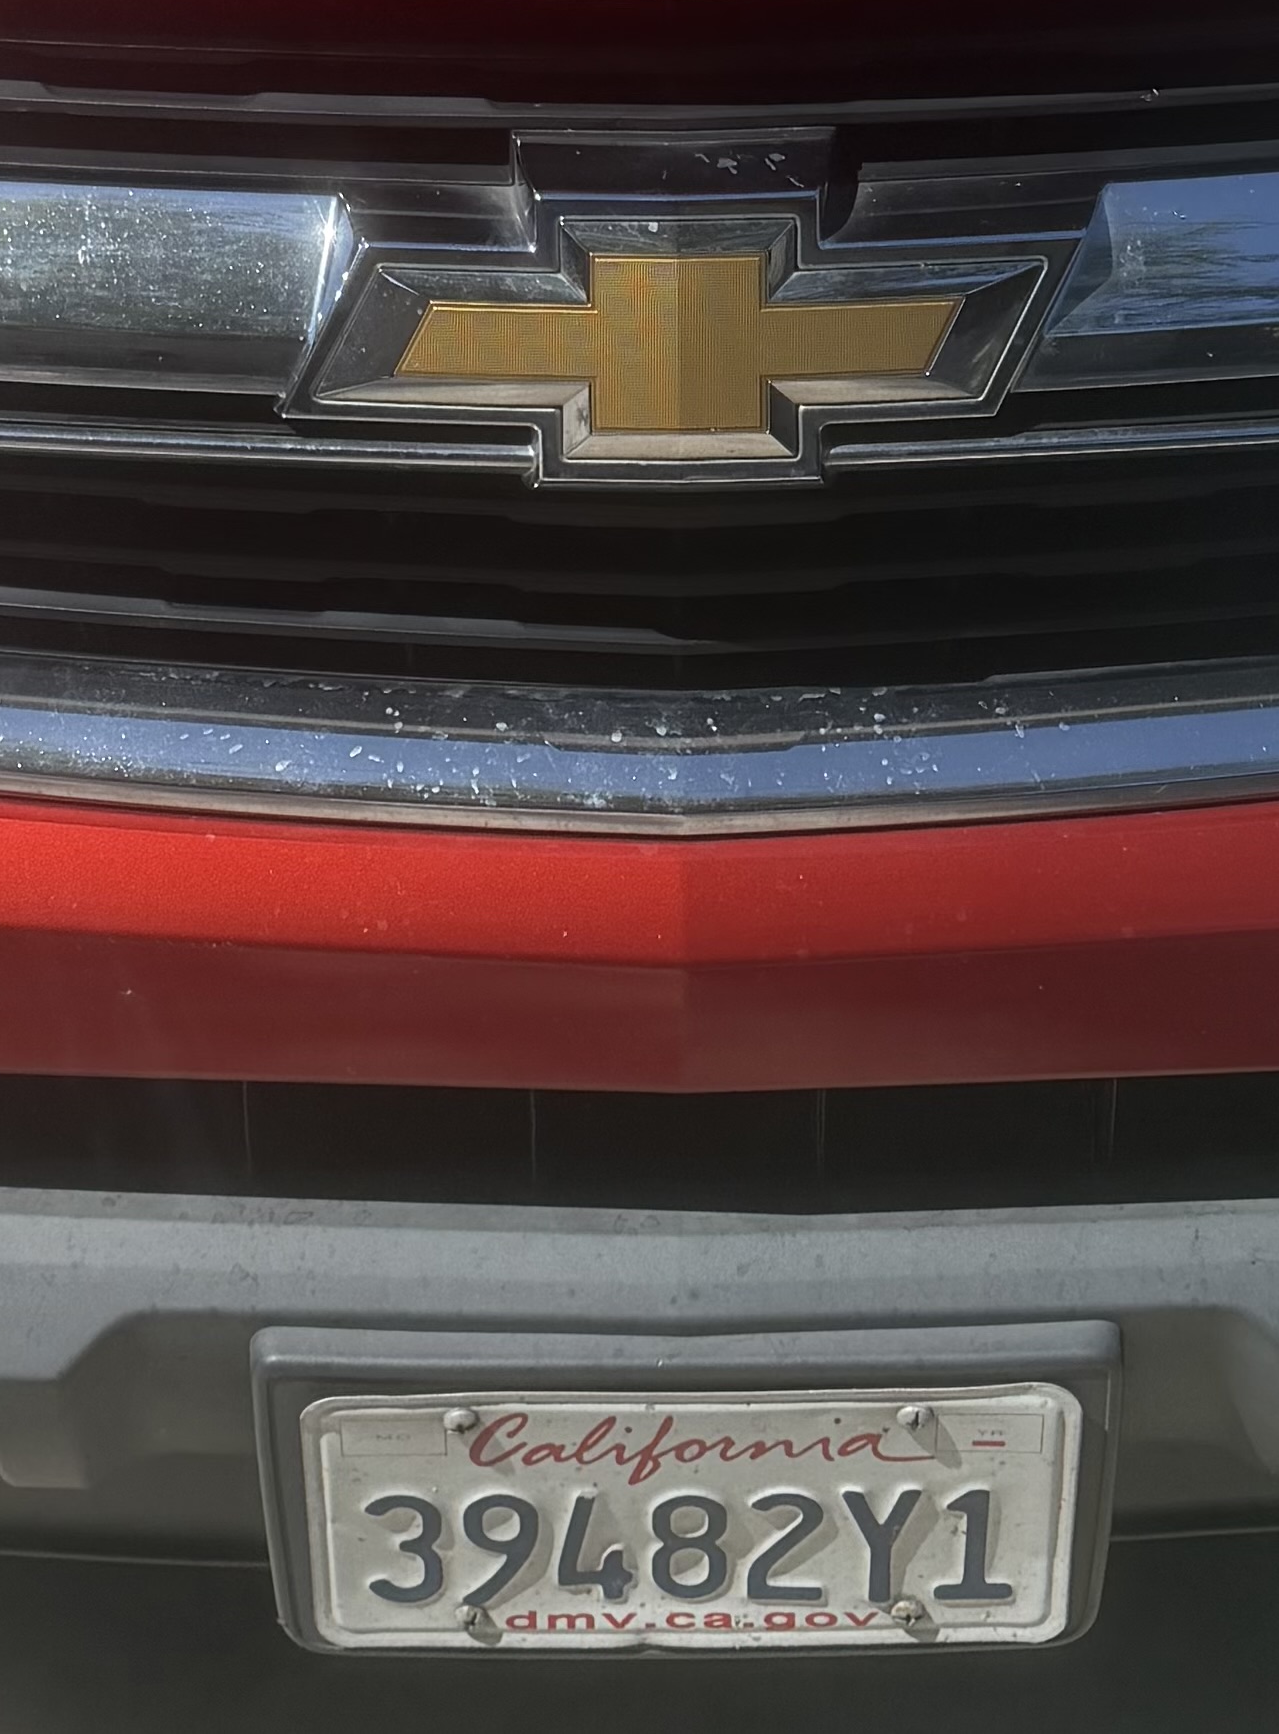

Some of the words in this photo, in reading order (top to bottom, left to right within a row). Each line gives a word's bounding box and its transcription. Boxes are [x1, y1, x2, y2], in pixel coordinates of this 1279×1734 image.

[468, 1412, 935, 1486] California
[363, 1488, 1013, 1605] 39482Y1
[504, 1609, 880, 1632] dmv.ca.gov
